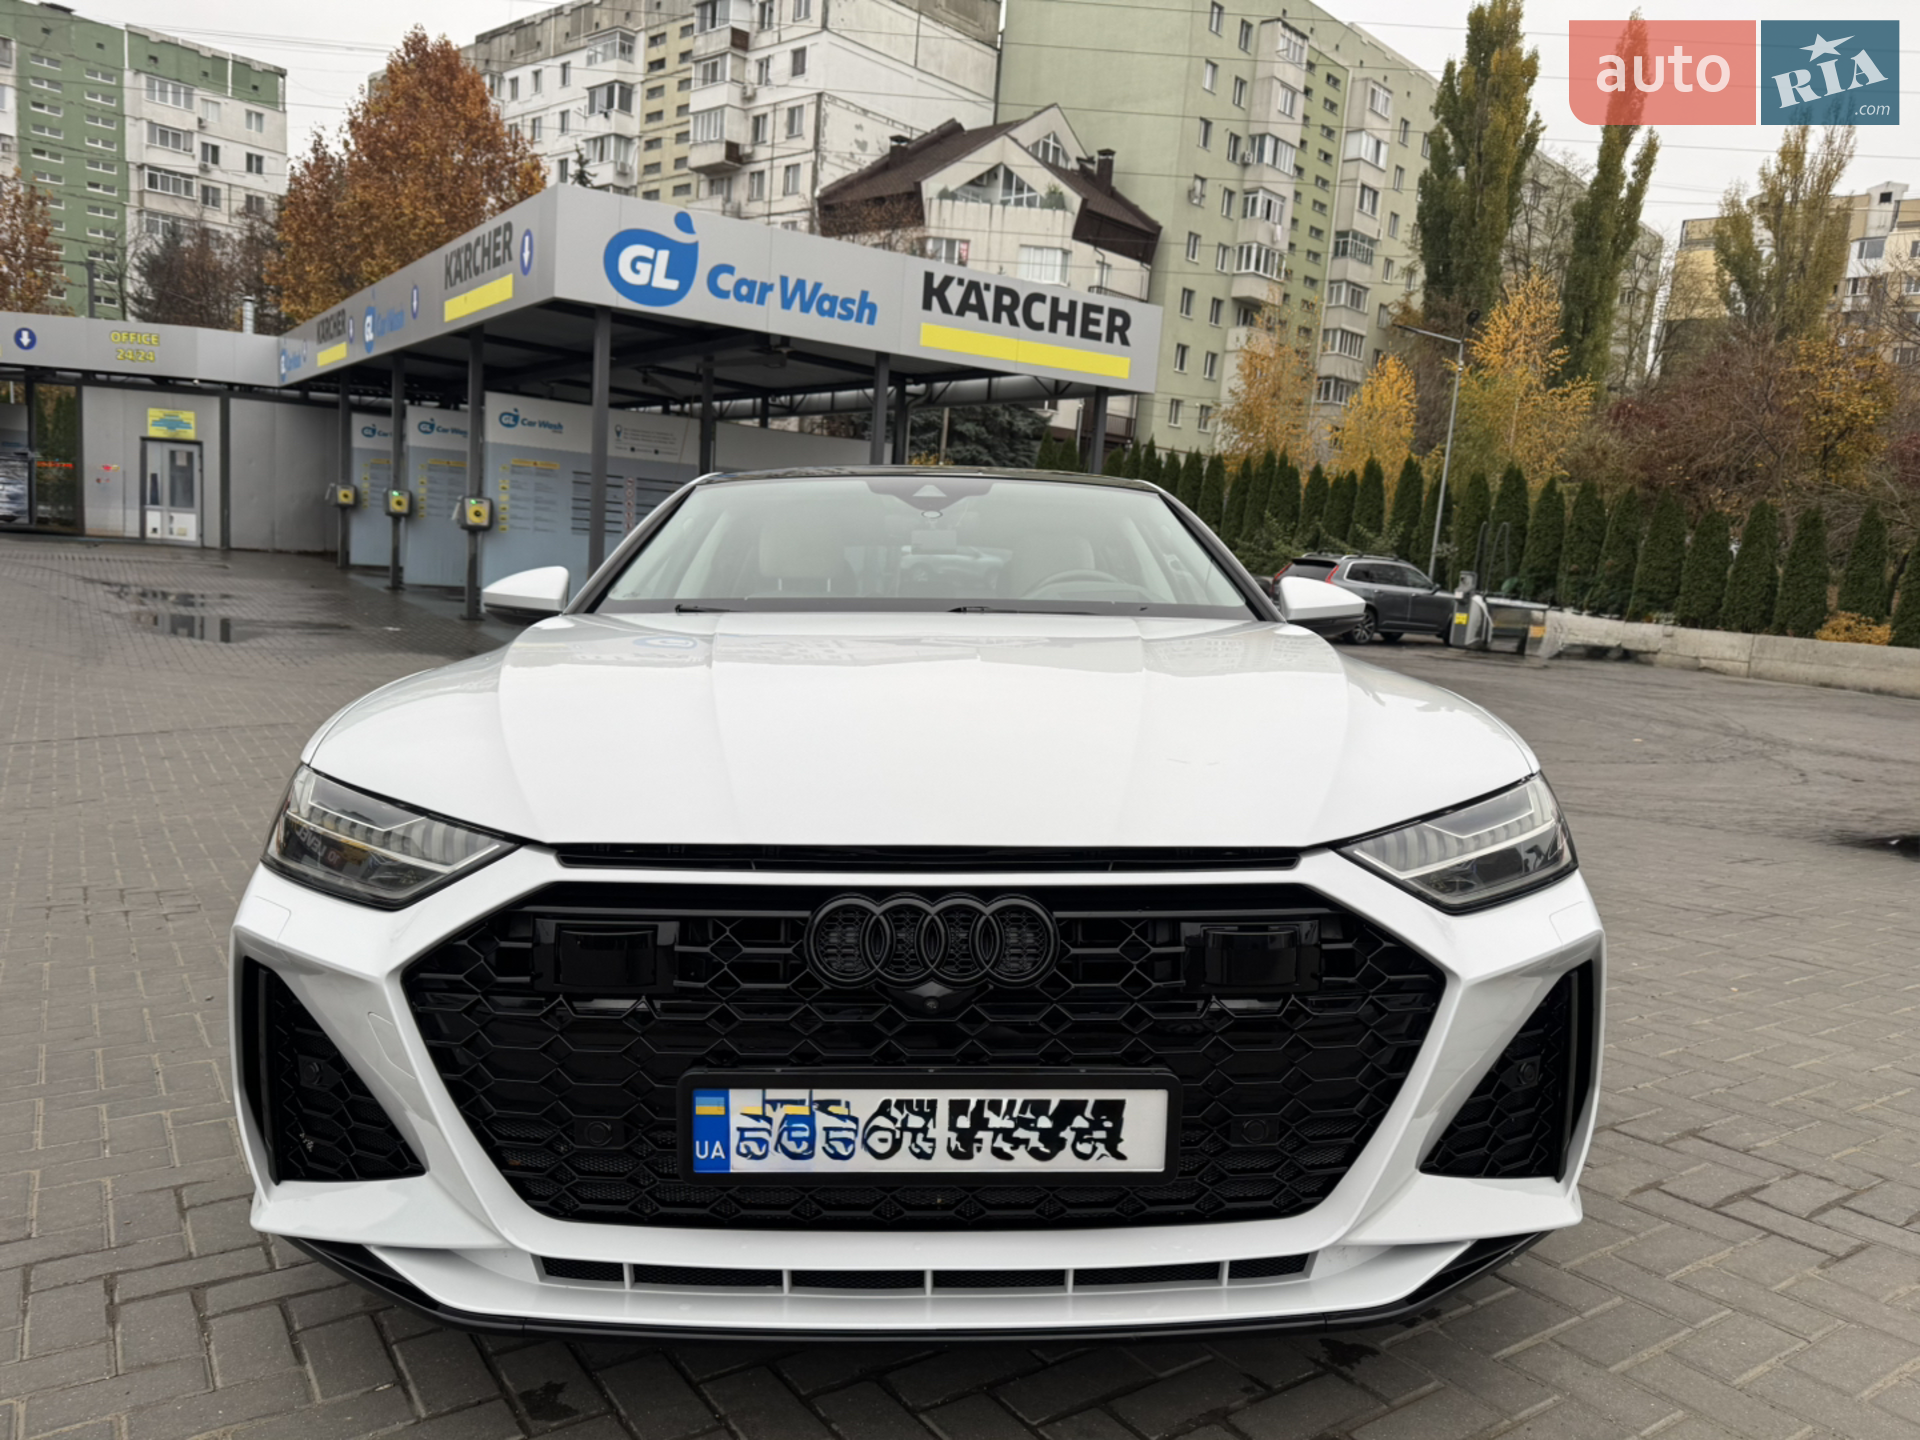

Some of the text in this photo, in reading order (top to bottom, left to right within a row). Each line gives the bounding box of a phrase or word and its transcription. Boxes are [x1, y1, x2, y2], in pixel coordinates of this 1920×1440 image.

[444, 221, 514, 290] KÄRCHER
[618, 243, 878, 326] GL Car Wash
[921, 270, 1132, 347] KÄRCHER
[110, 331, 160, 346] OFFICE
[116, 348, 155, 363] 24/24
[520, 417, 537, 427] Car
[538, 419, 564, 431] Wash
[695, 1140, 726, 1160] UA
